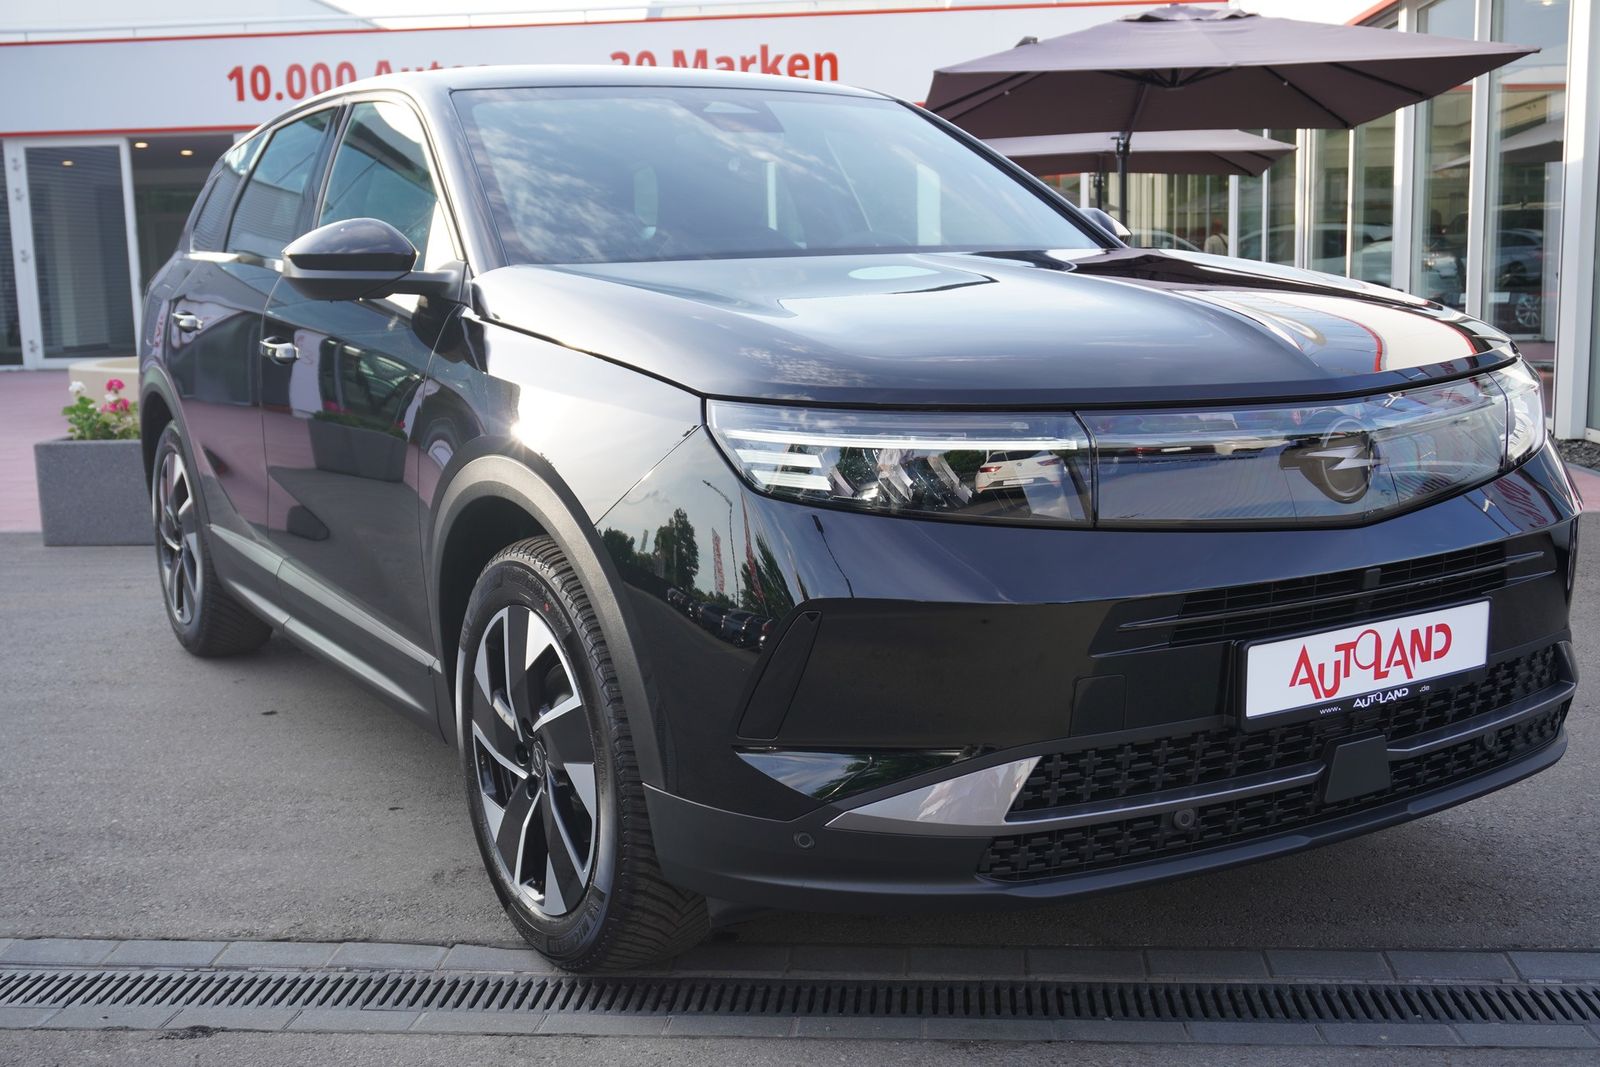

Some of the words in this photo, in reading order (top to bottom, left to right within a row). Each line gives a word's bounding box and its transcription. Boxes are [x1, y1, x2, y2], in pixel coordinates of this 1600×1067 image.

[227, 61, 357, 102] 10.000
[1288, 623, 1453, 700] AUTOLAND
[1319, 706, 1341, 715] www.
[1352, 687, 1409, 708] AUTOLAND
[1419, 684, 1430, 692] .de
